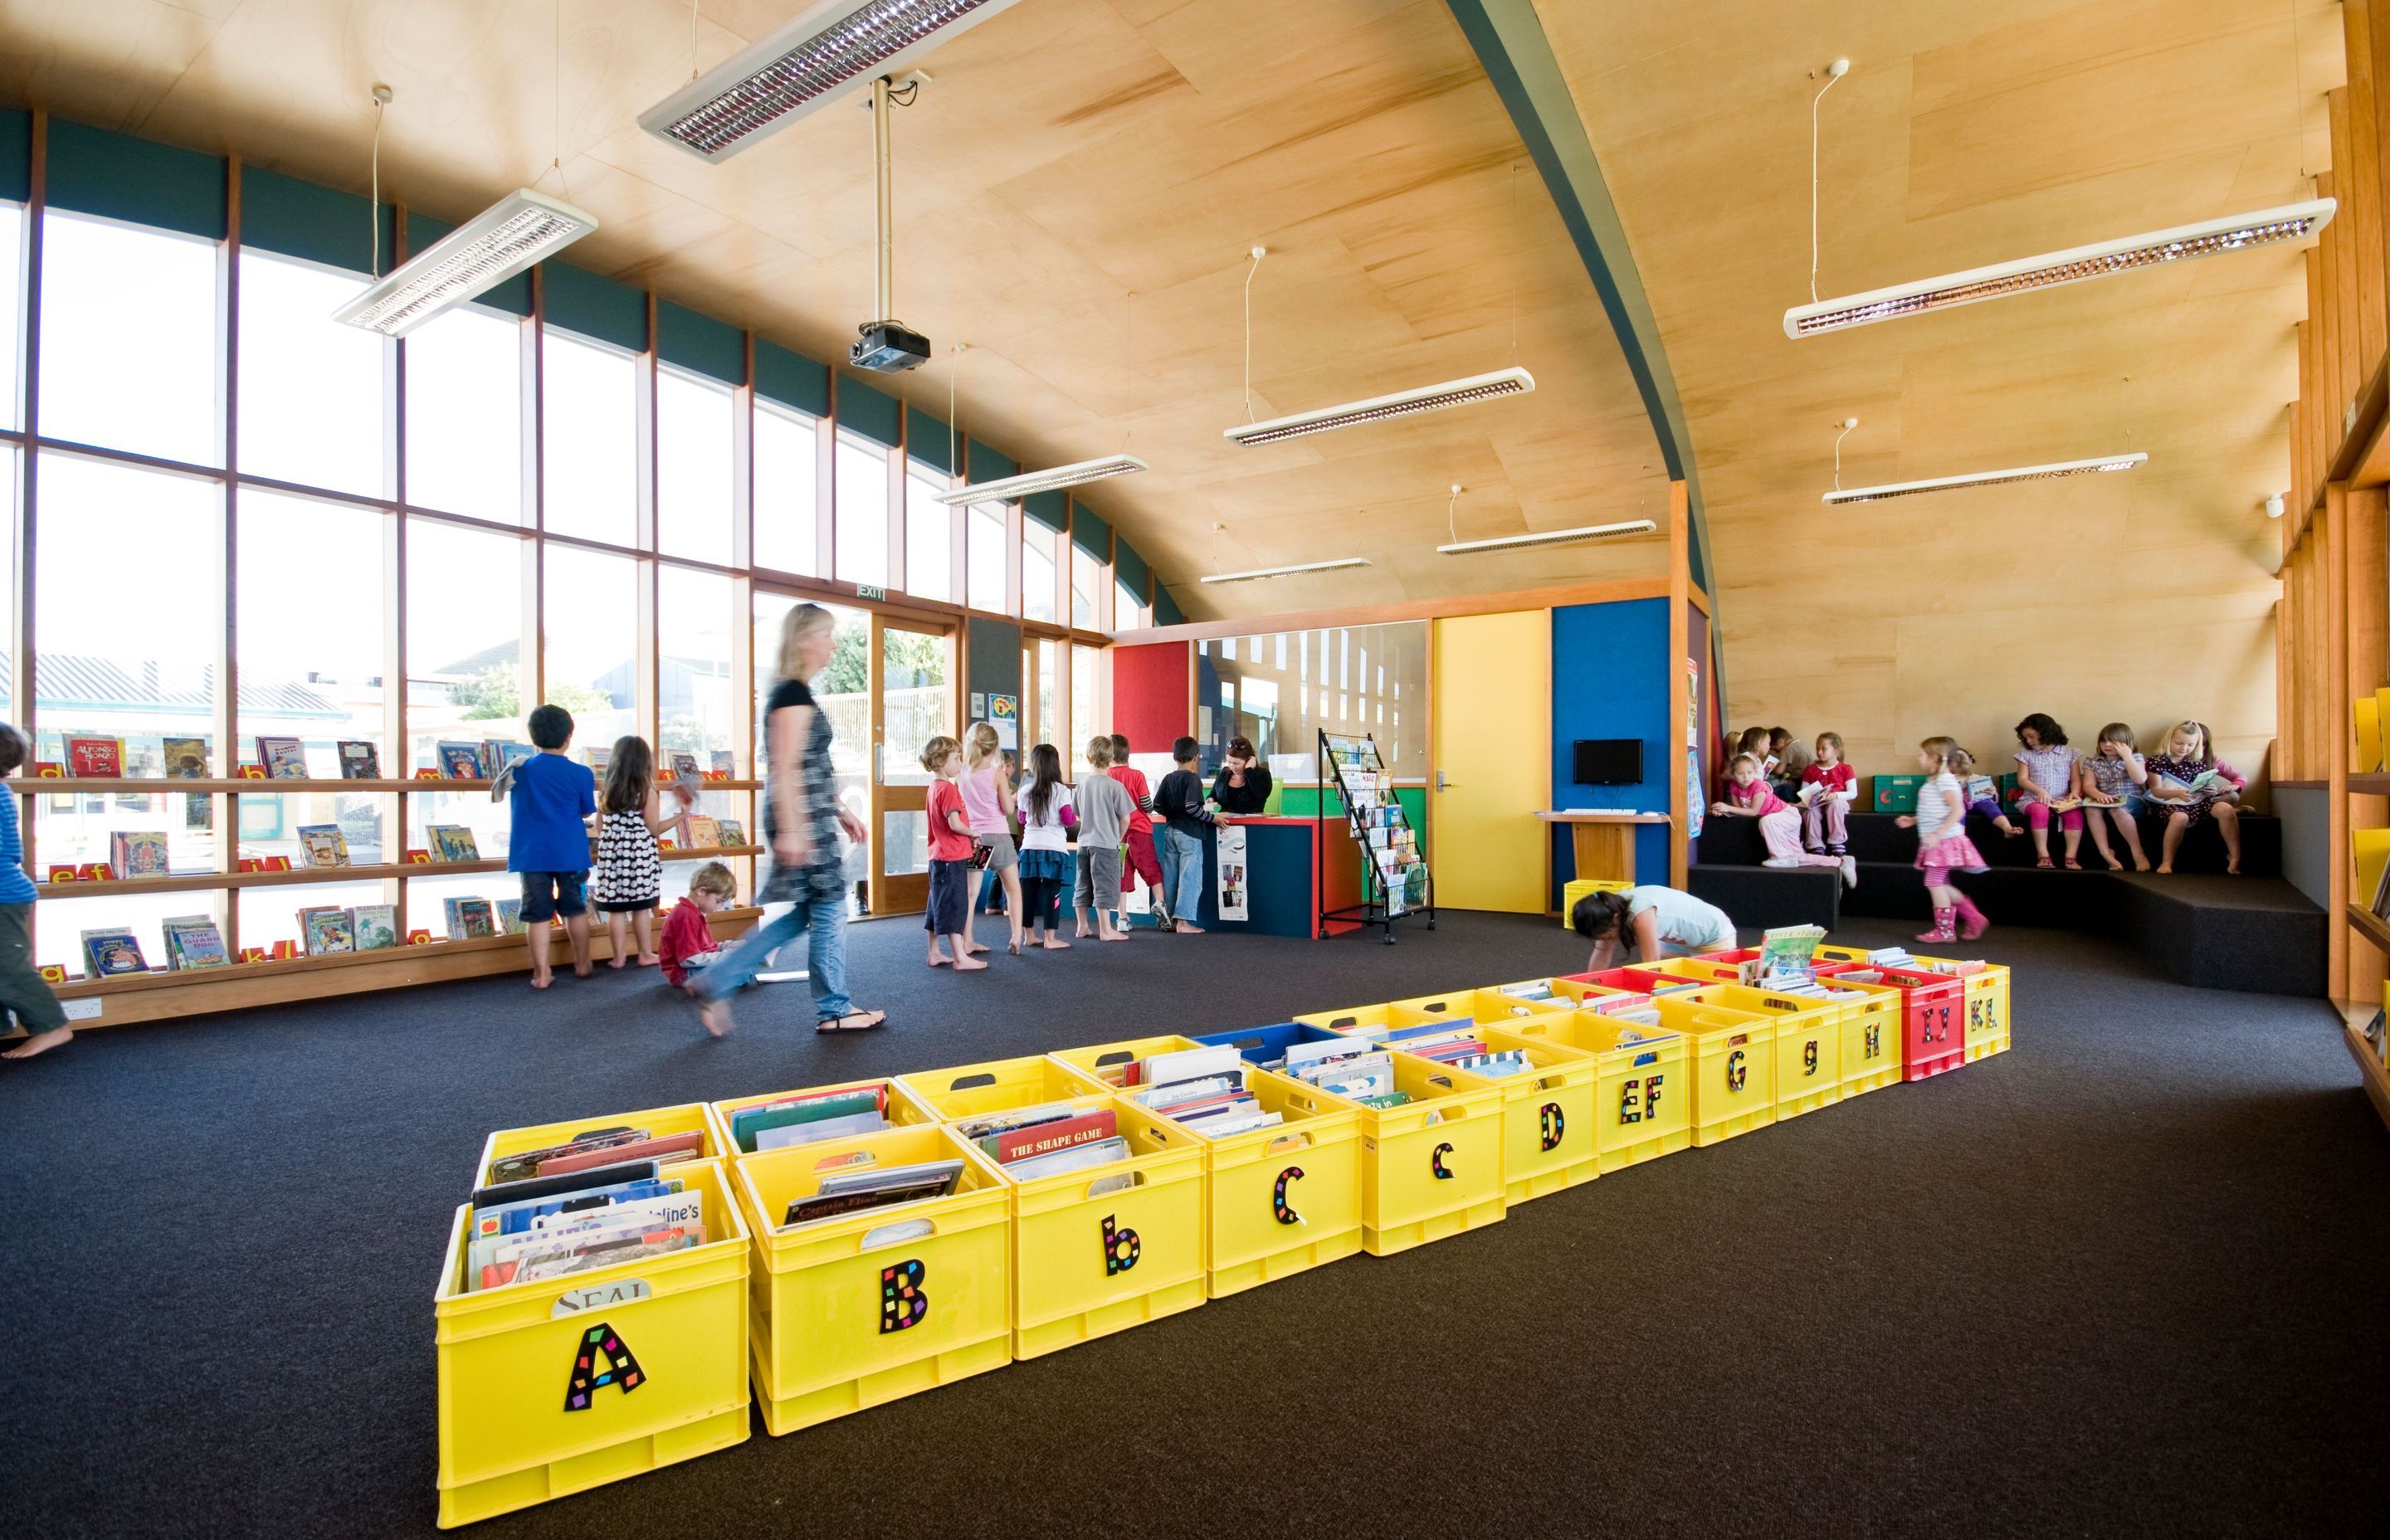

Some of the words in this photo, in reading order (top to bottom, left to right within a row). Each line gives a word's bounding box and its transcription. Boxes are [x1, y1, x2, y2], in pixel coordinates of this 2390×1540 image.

[859, 584, 884, 599] EXIT
[76, 745, 116, 753] ALFONSO
[85, 752, 115, 760] BONZO
[1880, 789, 1893, 804] C
[52, 870, 75, 884] e
[90, 864, 105, 882] f
[184, 936, 220, 944] GUARD
[246, 949, 262, 963] k
[1922, 1007, 1950, 1043] IJ
[1970, 997, 1998, 1032] KL
[1866, 1021, 1880, 1060] H
[1804, 1040, 1818, 1076] g
[1729, 1050, 1747, 1093] G
[1383, 1099, 1393, 1109] in
[1621, 1075, 1664, 1125] EF
[1540, 1102, 1565, 1153] D
[1010, 1143, 1033, 1158] THE
[1036, 1134, 1072, 1153] SHAPE
[1074, 1128, 1103, 1143] GAME
[650, 1204, 699, 1223] line's
[799, 1201, 845, 1217] Captain
[1101, 1213, 1141, 1277] b
[879, 1258, 928, 1335] B
[563, 1322, 647, 1413] A
